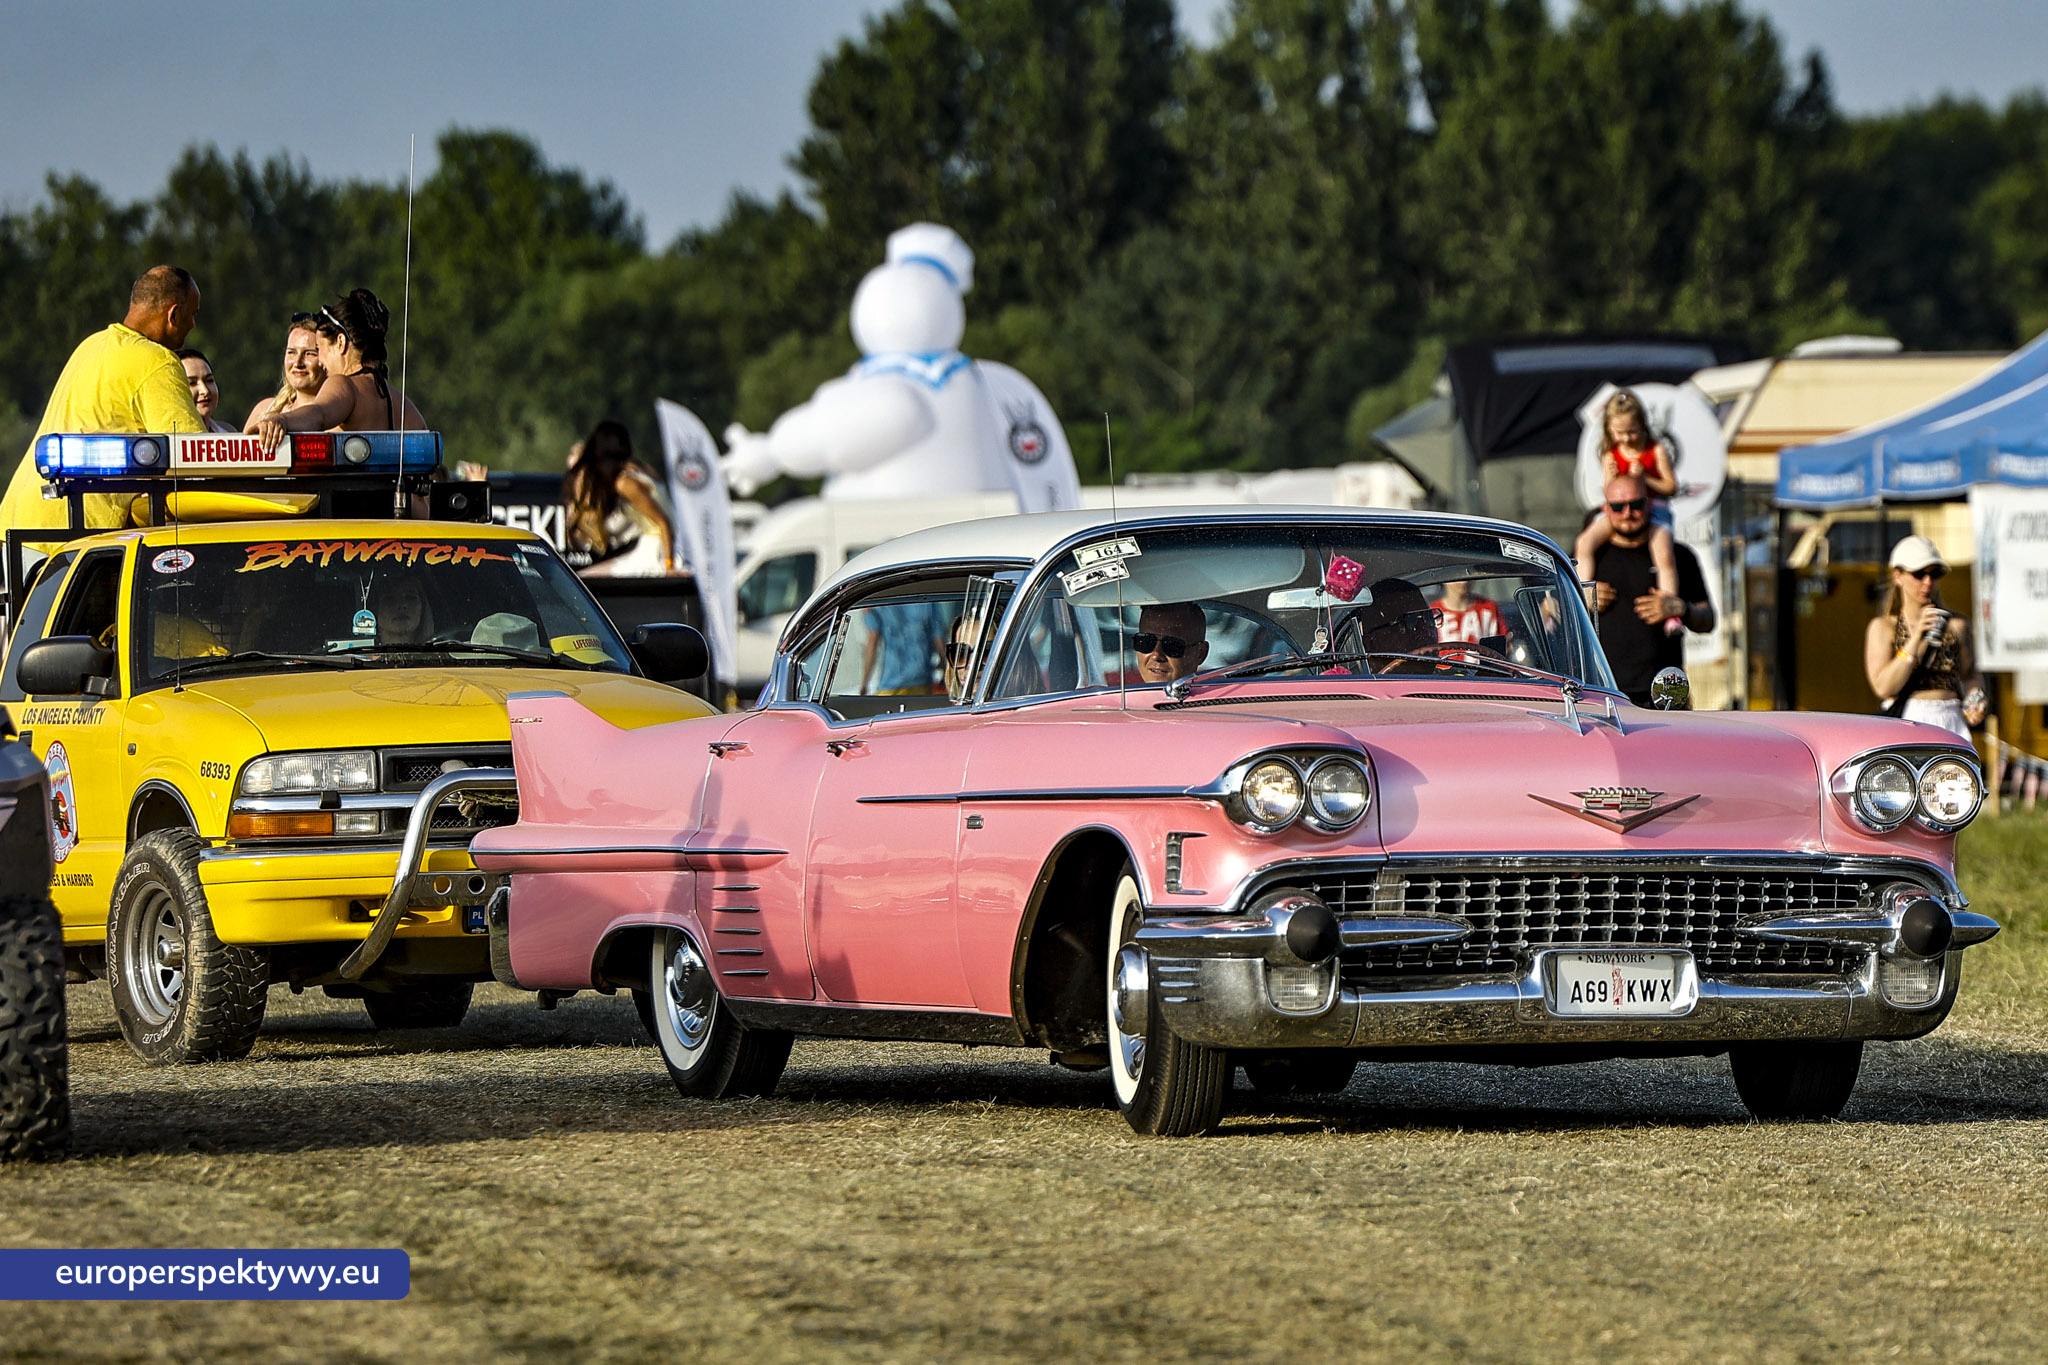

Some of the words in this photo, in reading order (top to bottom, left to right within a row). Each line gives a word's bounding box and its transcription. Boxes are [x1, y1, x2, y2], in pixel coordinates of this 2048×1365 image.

[234, 538, 516, 573] BAYWATCH
[1096, 545, 1122, 558] 164
[22, 707, 38, 725] LOS
[37, 707, 72, 725] ANGELES
[72, 707, 107, 725] COUNTY
[200, 760, 231, 781] 68393
[61, 873, 66, 887] &
[66, 873, 94, 887] HARBORS
[472, 911, 483, 920] PL
[109, 862, 151, 989] WRANGLER
[1586, 954, 1613, 964] NEW
[1614, 953, 1646, 964] YORK
[1570, 980, 1608, 1003] A69
[1627, 979, 1672, 1003] KWX
